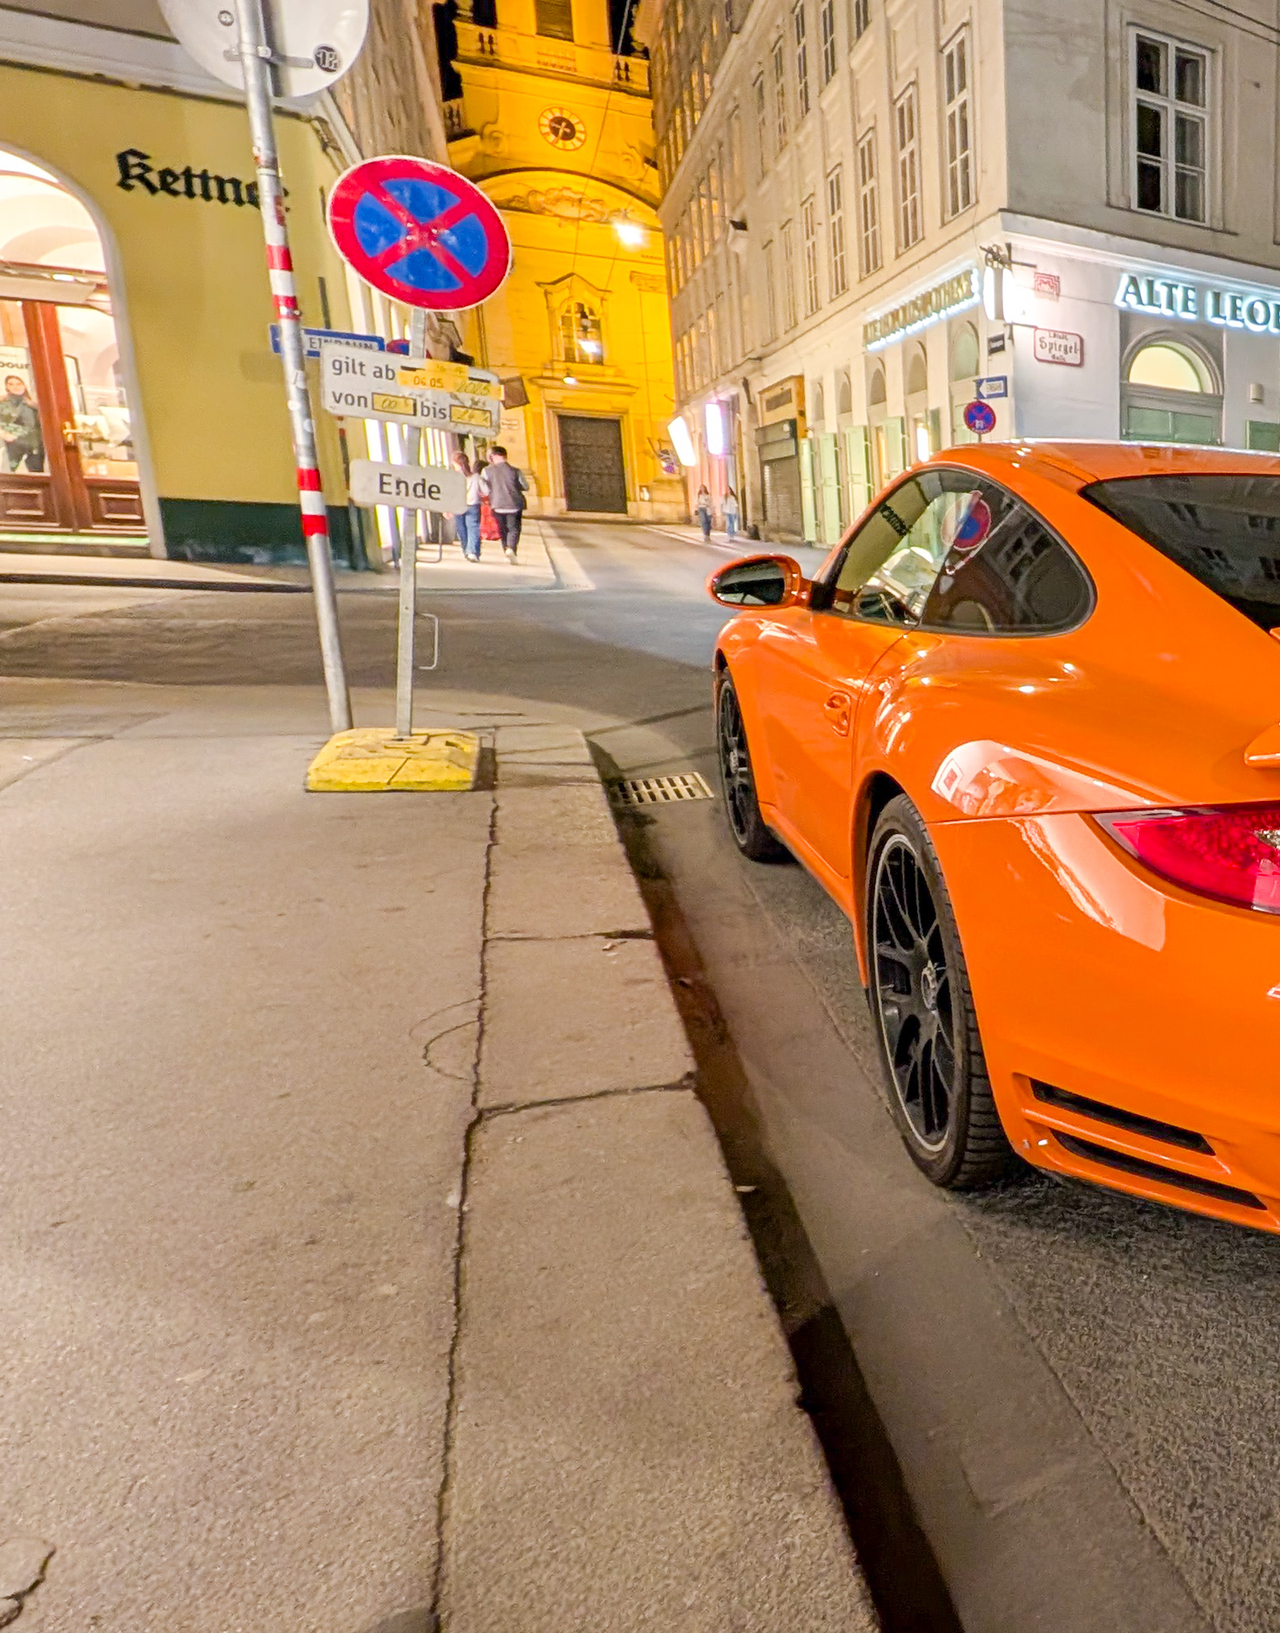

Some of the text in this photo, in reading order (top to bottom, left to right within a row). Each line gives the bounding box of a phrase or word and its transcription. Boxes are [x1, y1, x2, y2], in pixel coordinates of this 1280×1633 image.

[1118, 274, 1198, 318] ALTE
[332, 356, 396, 381] gilt ab
[332, 391, 368, 408] von
[420, 400, 447, 420] bis
[379, 472, 441, 501] Ende
